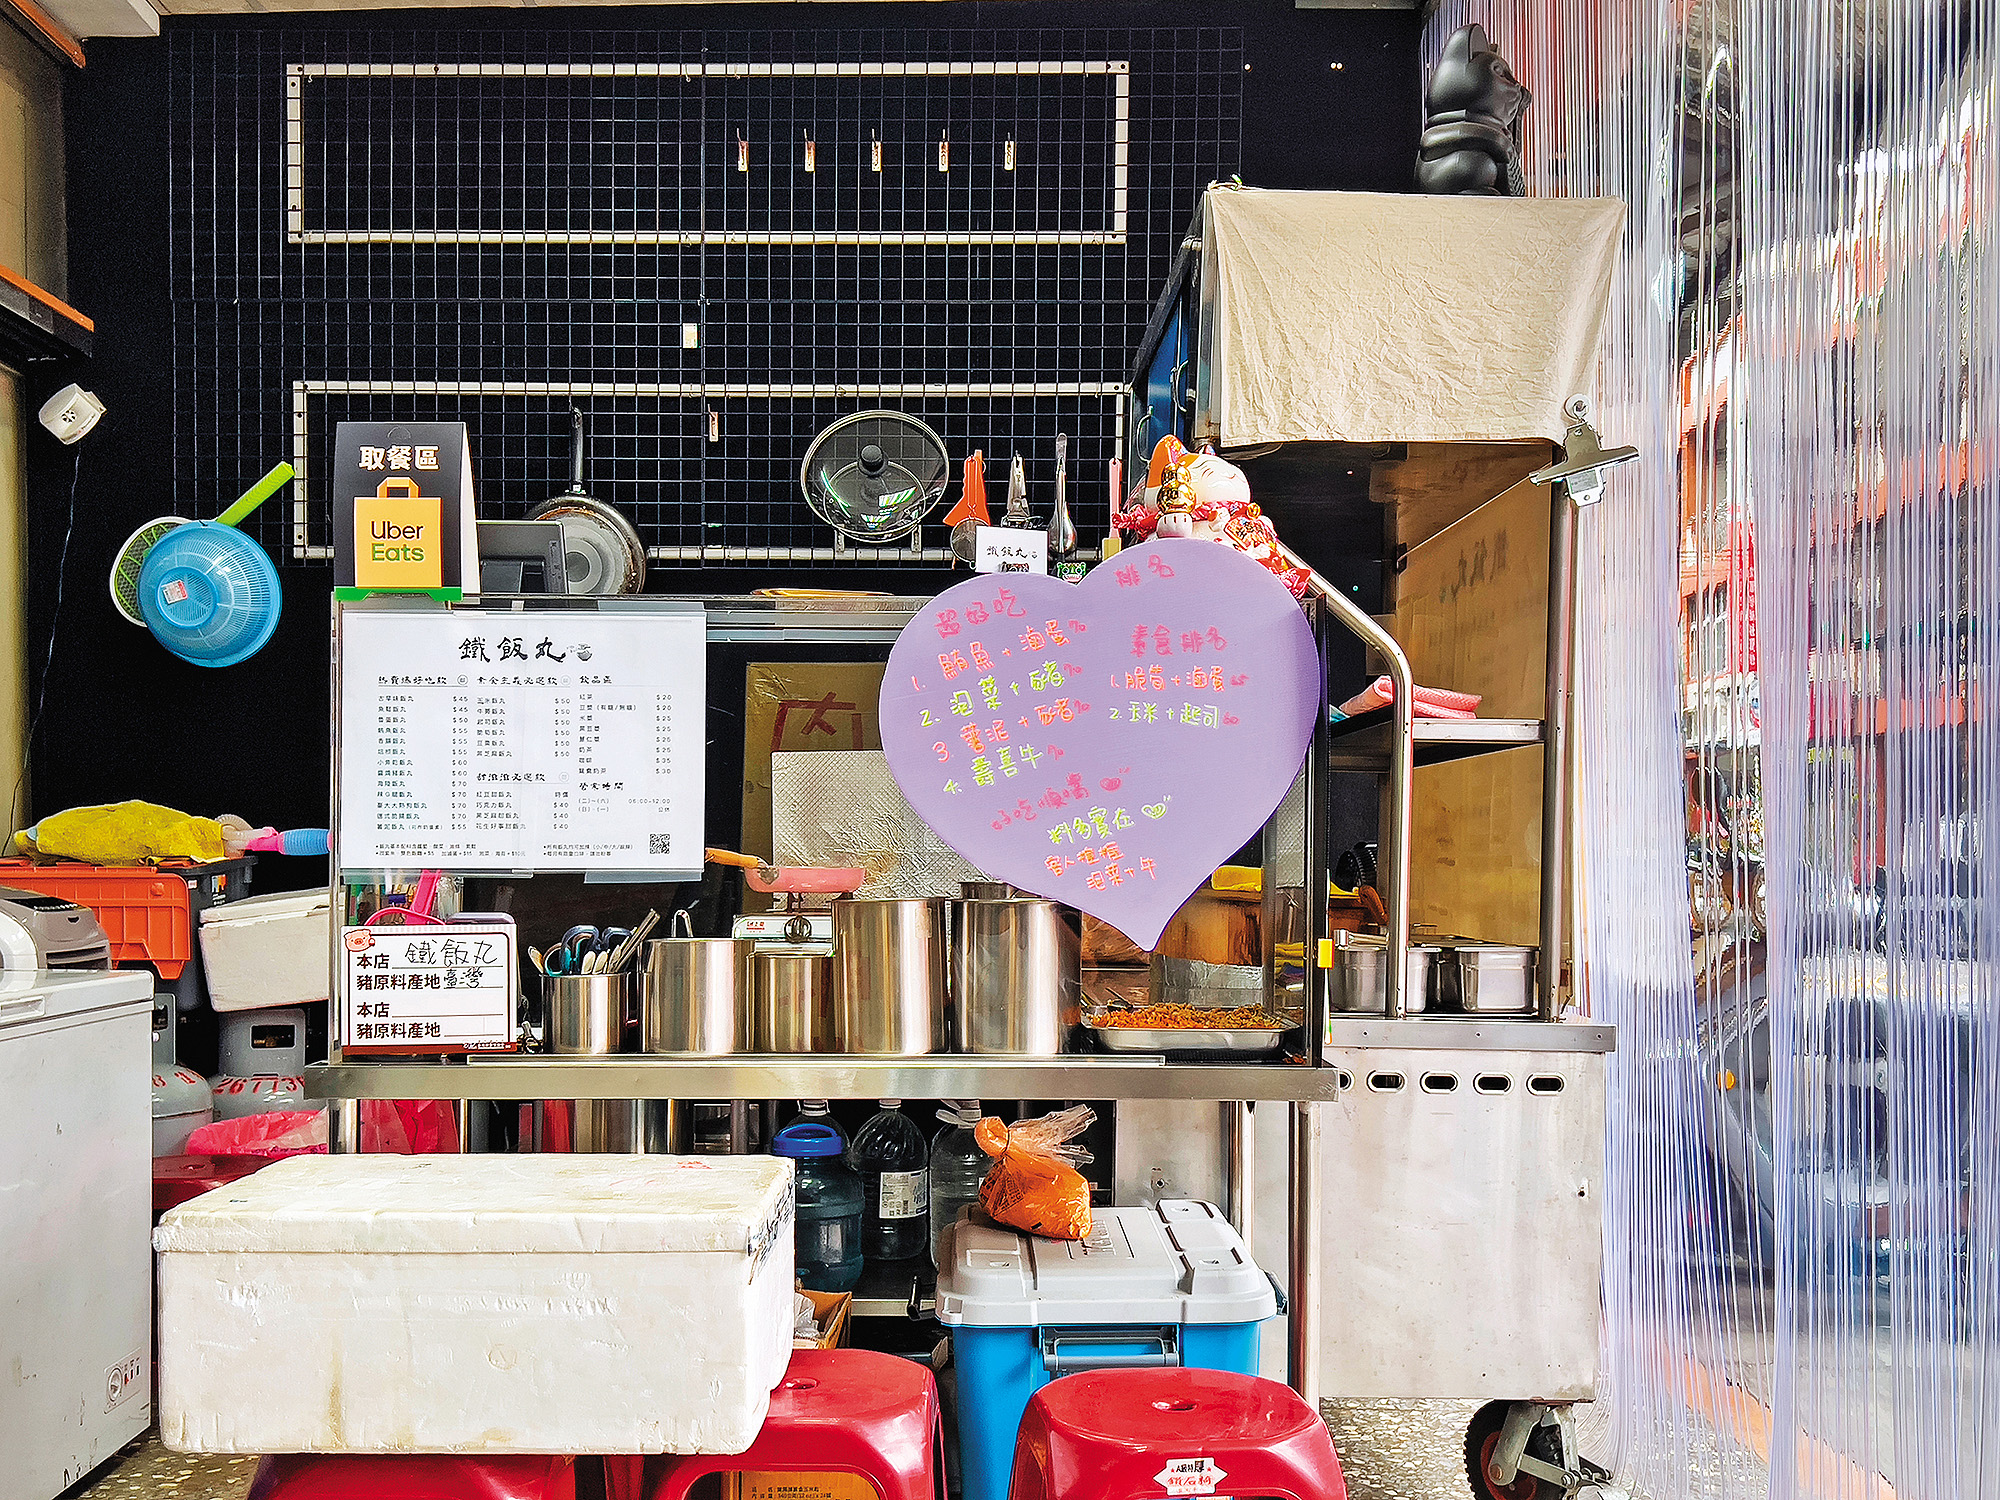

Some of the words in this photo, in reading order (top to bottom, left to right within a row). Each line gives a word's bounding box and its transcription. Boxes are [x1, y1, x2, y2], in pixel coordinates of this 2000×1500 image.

[358, 444, 440, 471] 取餐區
[371, 520, 424, 539] Uber
[371, 543, 425, 561] Eats
[458, 636, 566, 663] 鐵飯丸
[356, 952, 390, 970] 本店
[404, 938, 498, 967] 鐵飯丸
[356, 973, 441, 991] 豬原料產地
[356, 1001, 390, 1018] 本店
[356, 1022, 441, 1039] 豬原料產地
